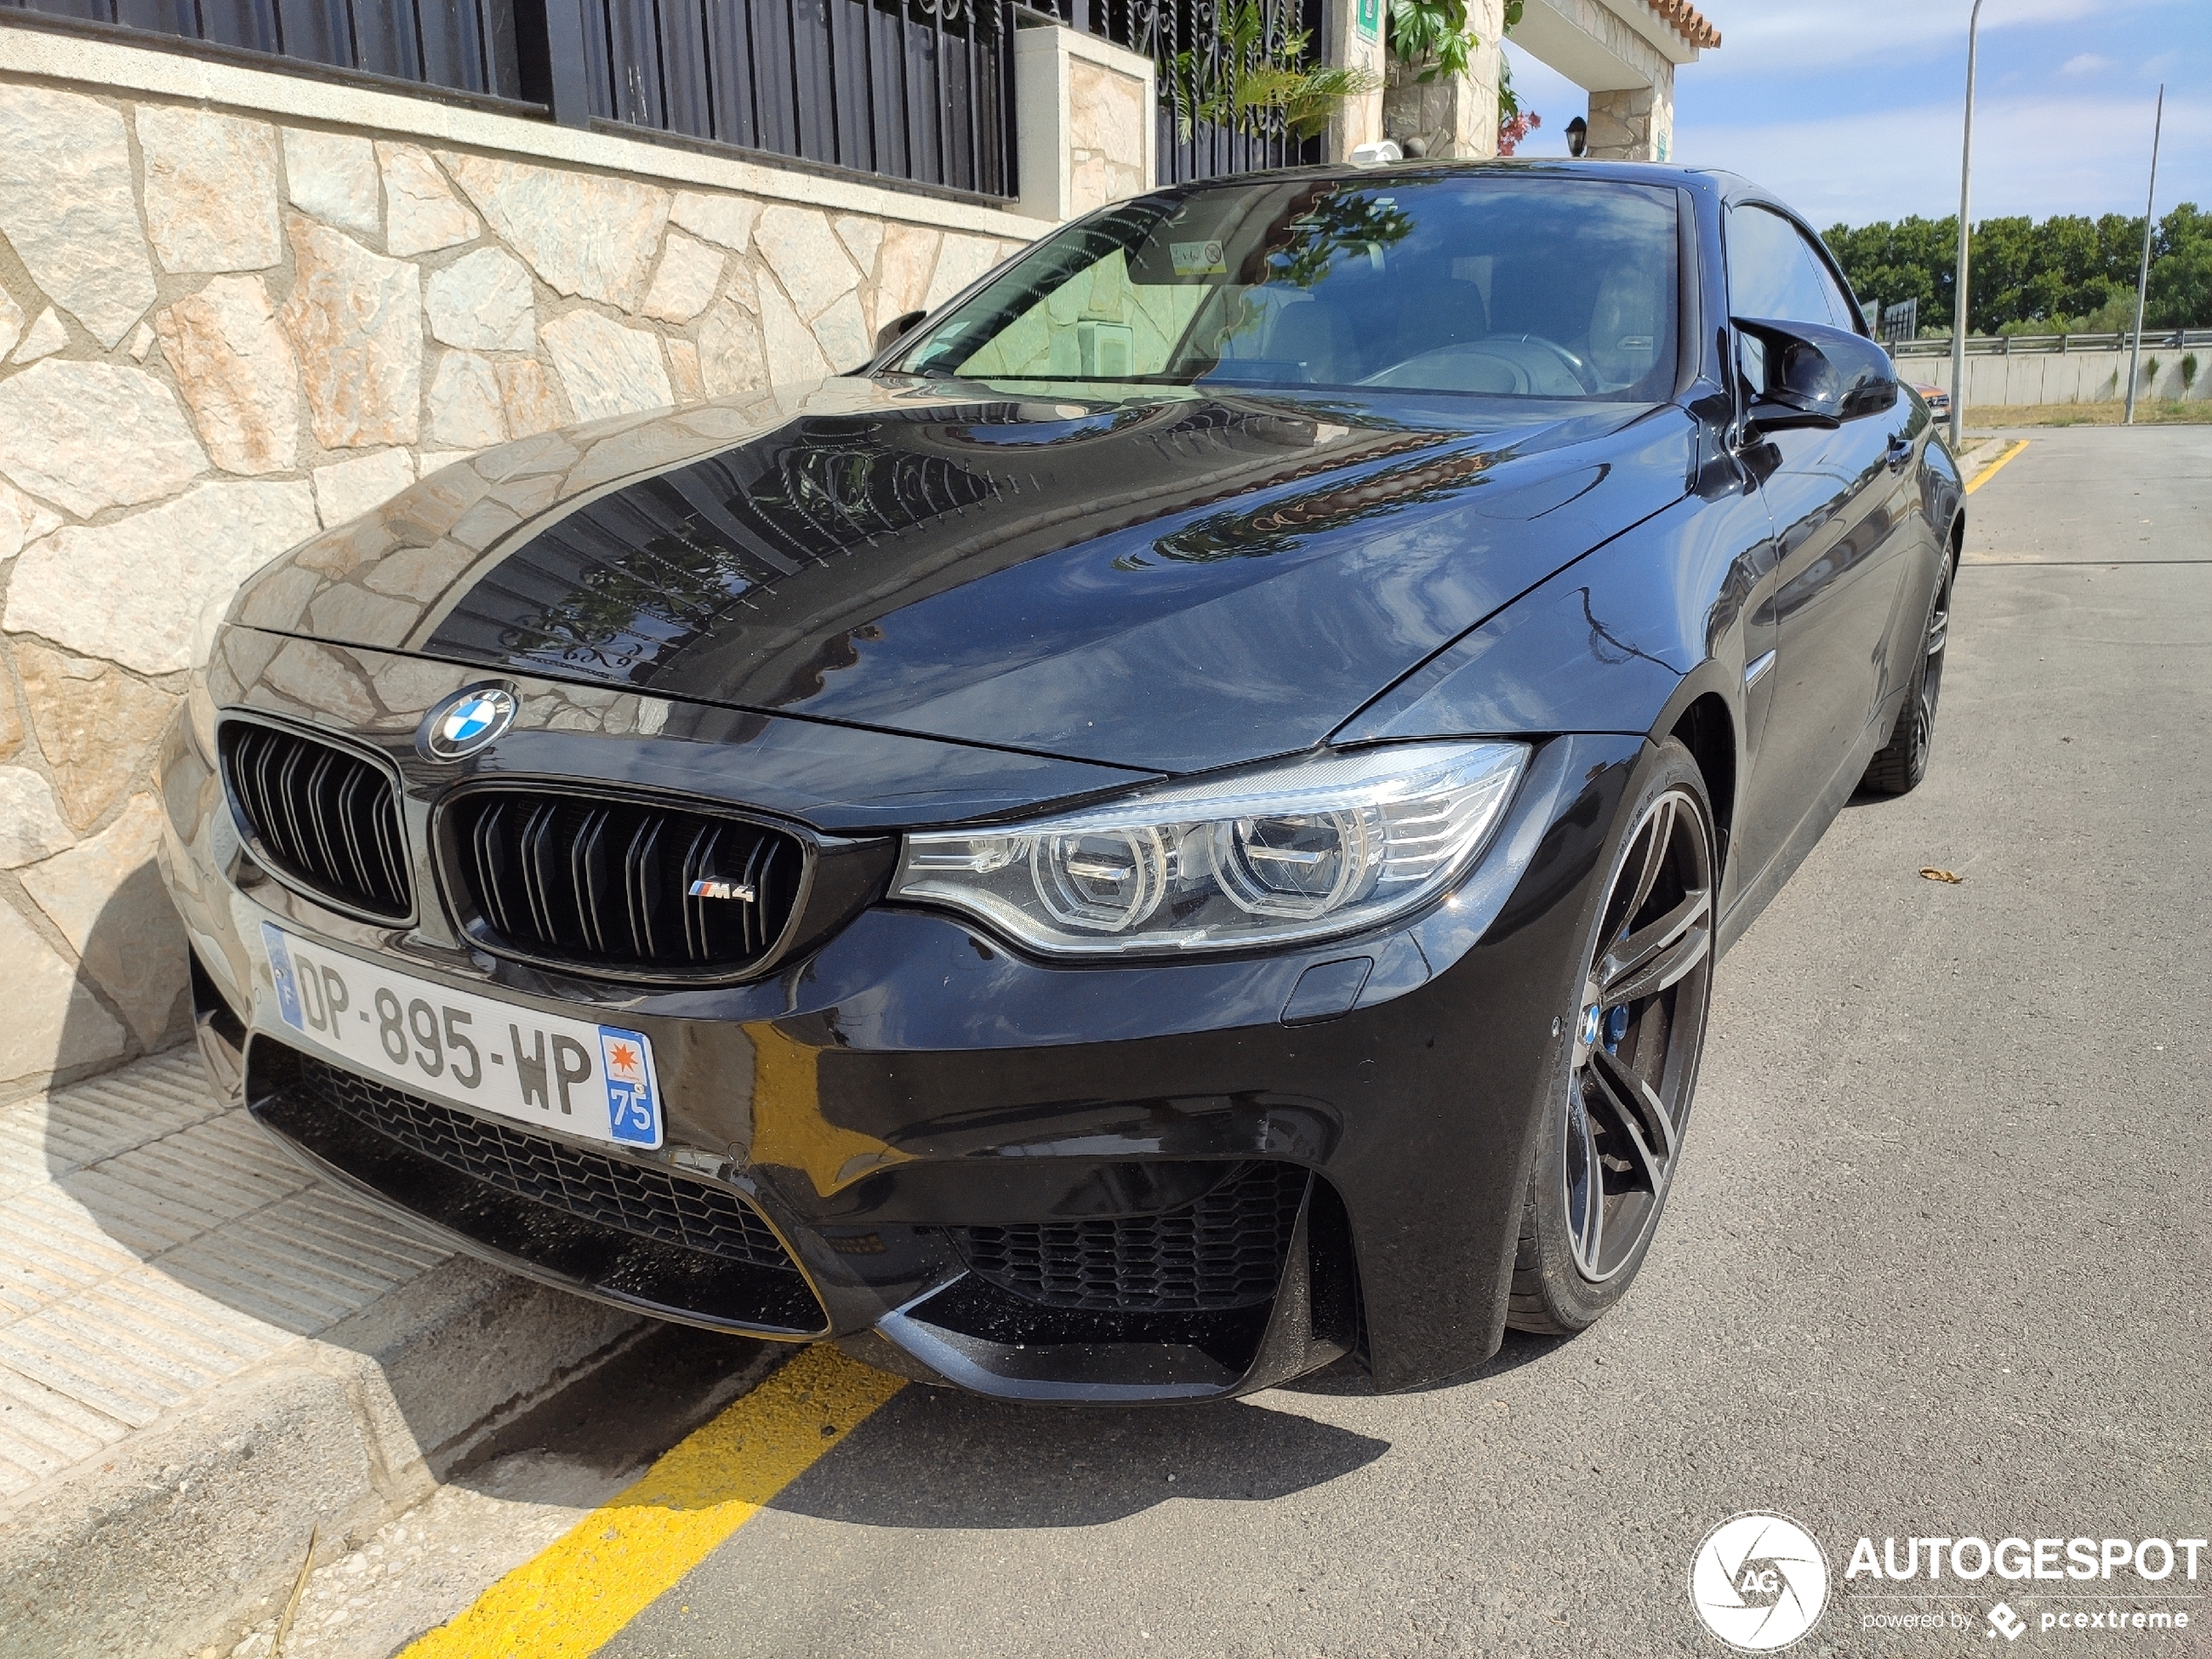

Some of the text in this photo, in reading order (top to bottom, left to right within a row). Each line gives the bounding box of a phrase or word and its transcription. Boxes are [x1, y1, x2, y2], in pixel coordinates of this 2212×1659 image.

[706, 881, 755, 903] M4
[293, 952, 593, 1116] DP-895-WP
[610, 1088, 651, 1130] 75
